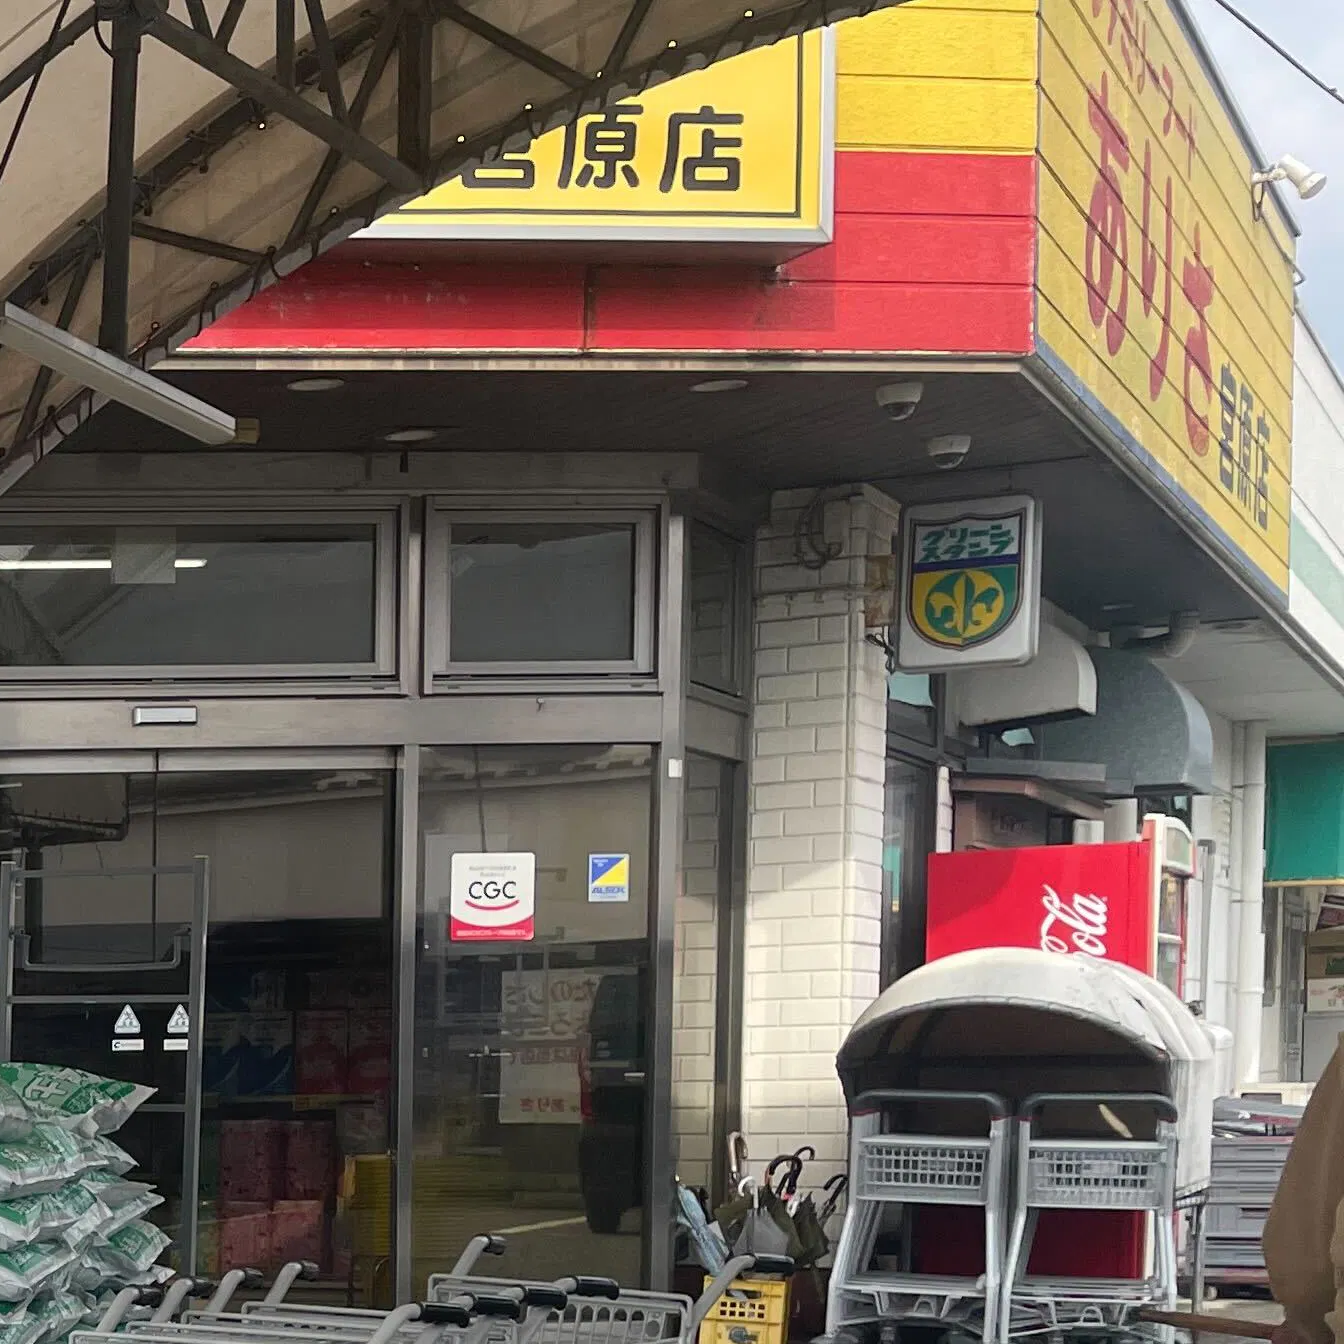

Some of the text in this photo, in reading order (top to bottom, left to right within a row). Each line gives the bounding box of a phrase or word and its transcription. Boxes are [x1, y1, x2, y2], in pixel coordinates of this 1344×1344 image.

[1091, 0, 1198, 182] ミリーフード
[1085, 70, 1271, 532] ありさ 宮原店
[922, 524, 1012, 546] グリーン
[468, 880, 517, 900] CGC
